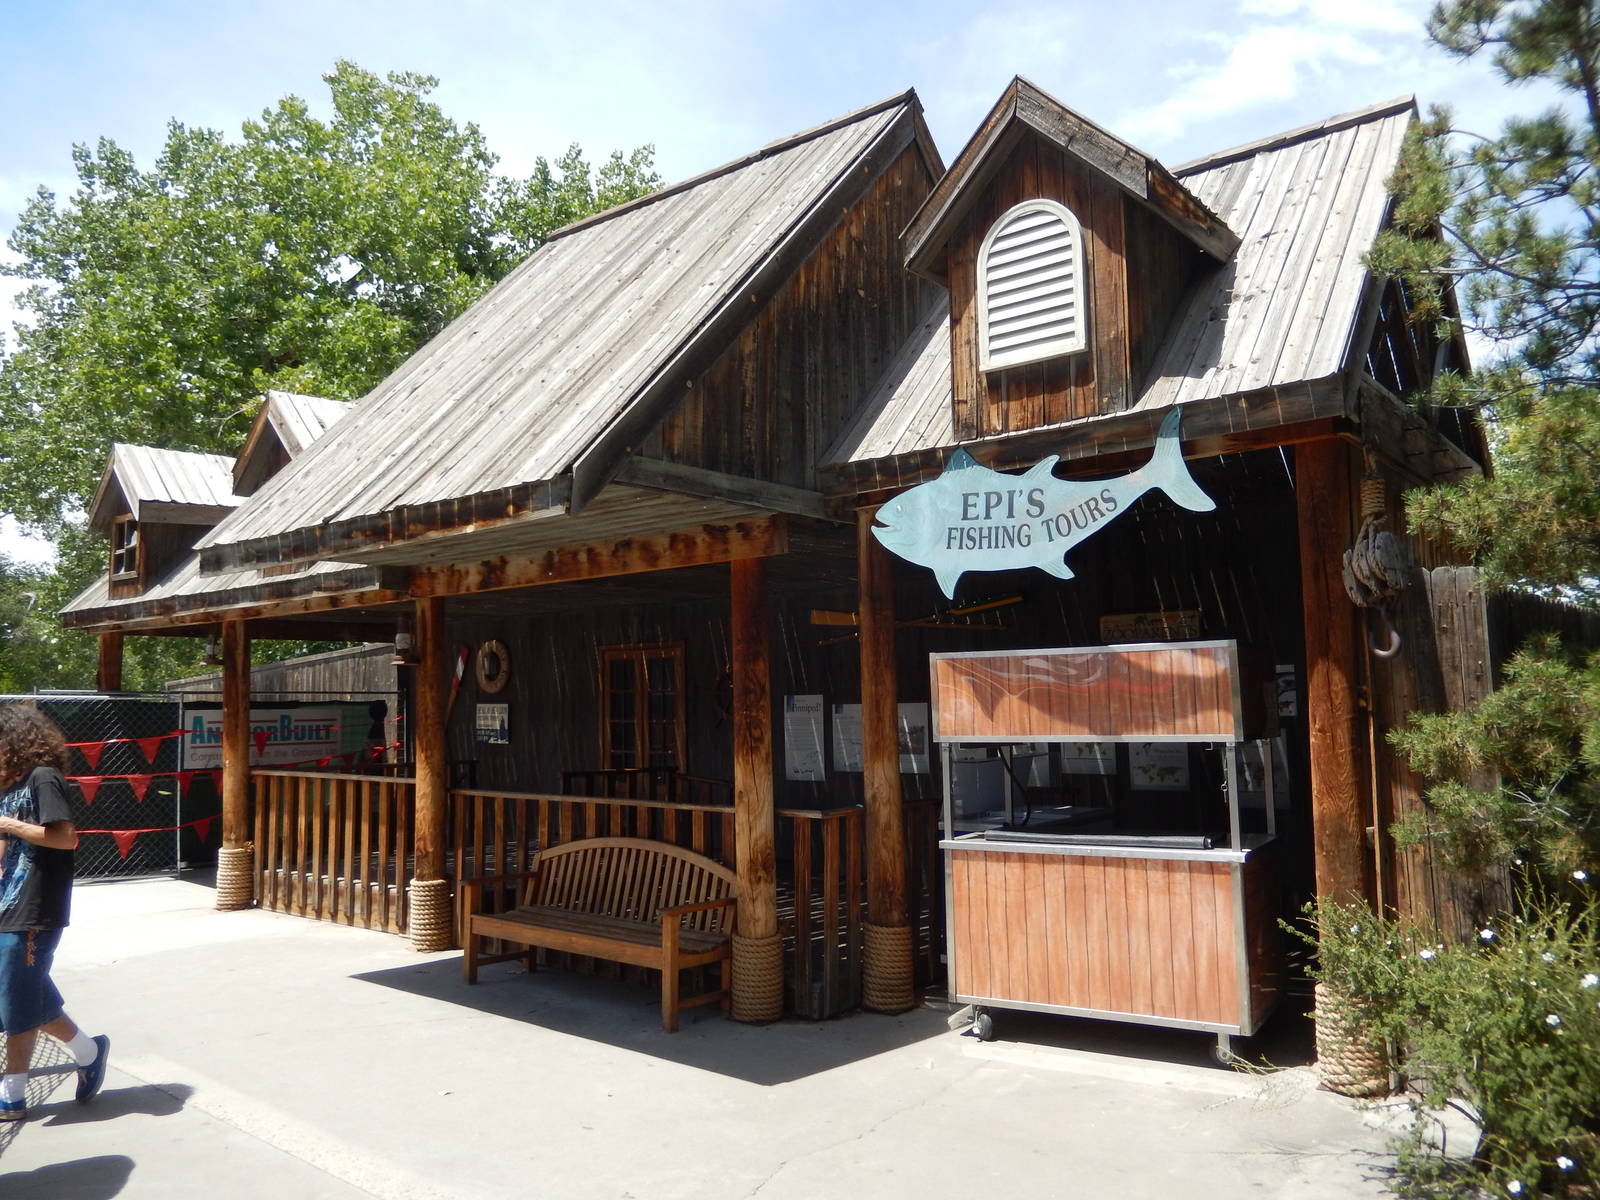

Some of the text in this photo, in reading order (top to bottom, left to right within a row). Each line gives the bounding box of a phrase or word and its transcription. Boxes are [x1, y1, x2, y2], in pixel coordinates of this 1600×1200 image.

[945, 488, 1118, 550] FISHING TOURS
[961, 488, 1045, 521] EPI'S
